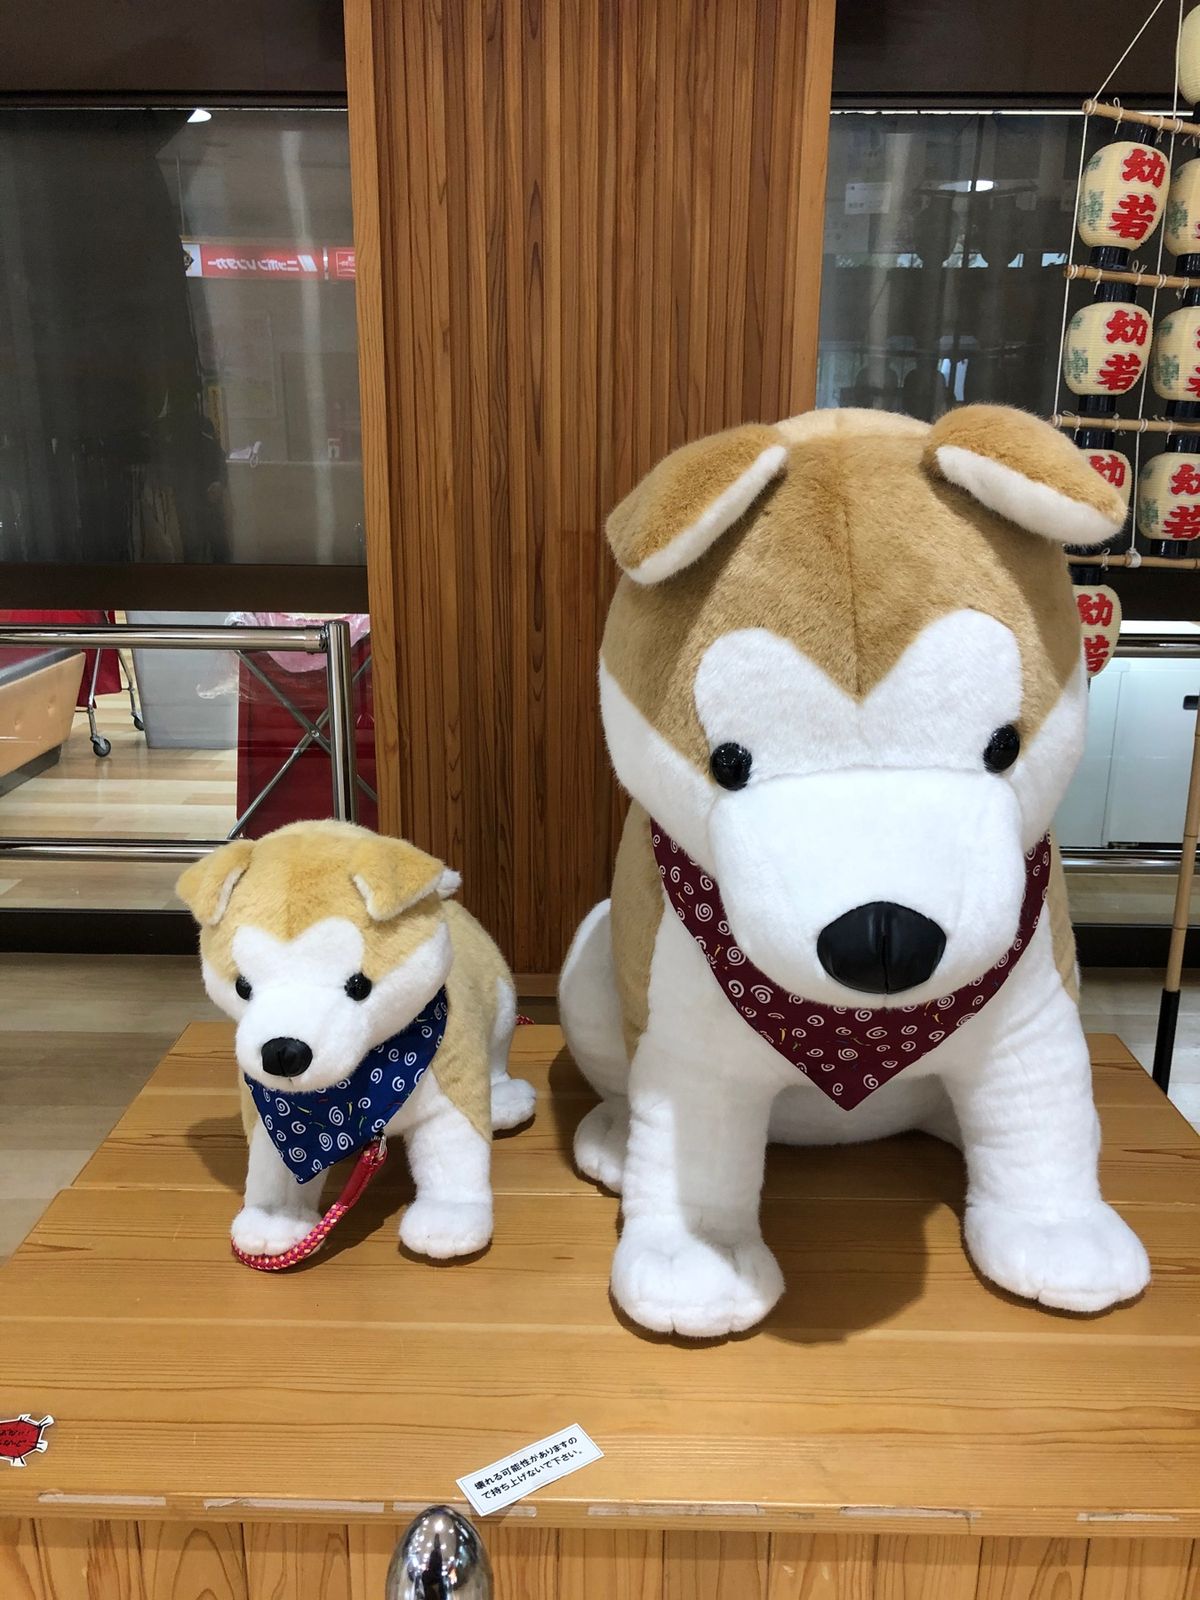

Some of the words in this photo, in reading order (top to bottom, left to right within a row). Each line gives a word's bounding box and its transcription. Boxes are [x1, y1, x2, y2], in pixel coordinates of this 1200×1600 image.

[1109, 149, 1165, 240] 幼若
[1097, 310, 1147, 391] 幼若
[474, 1436, 577, 1490] 壊れる可能性がありますの
[481, 1449, 583, 1499] で持ち上げないで下さい。
